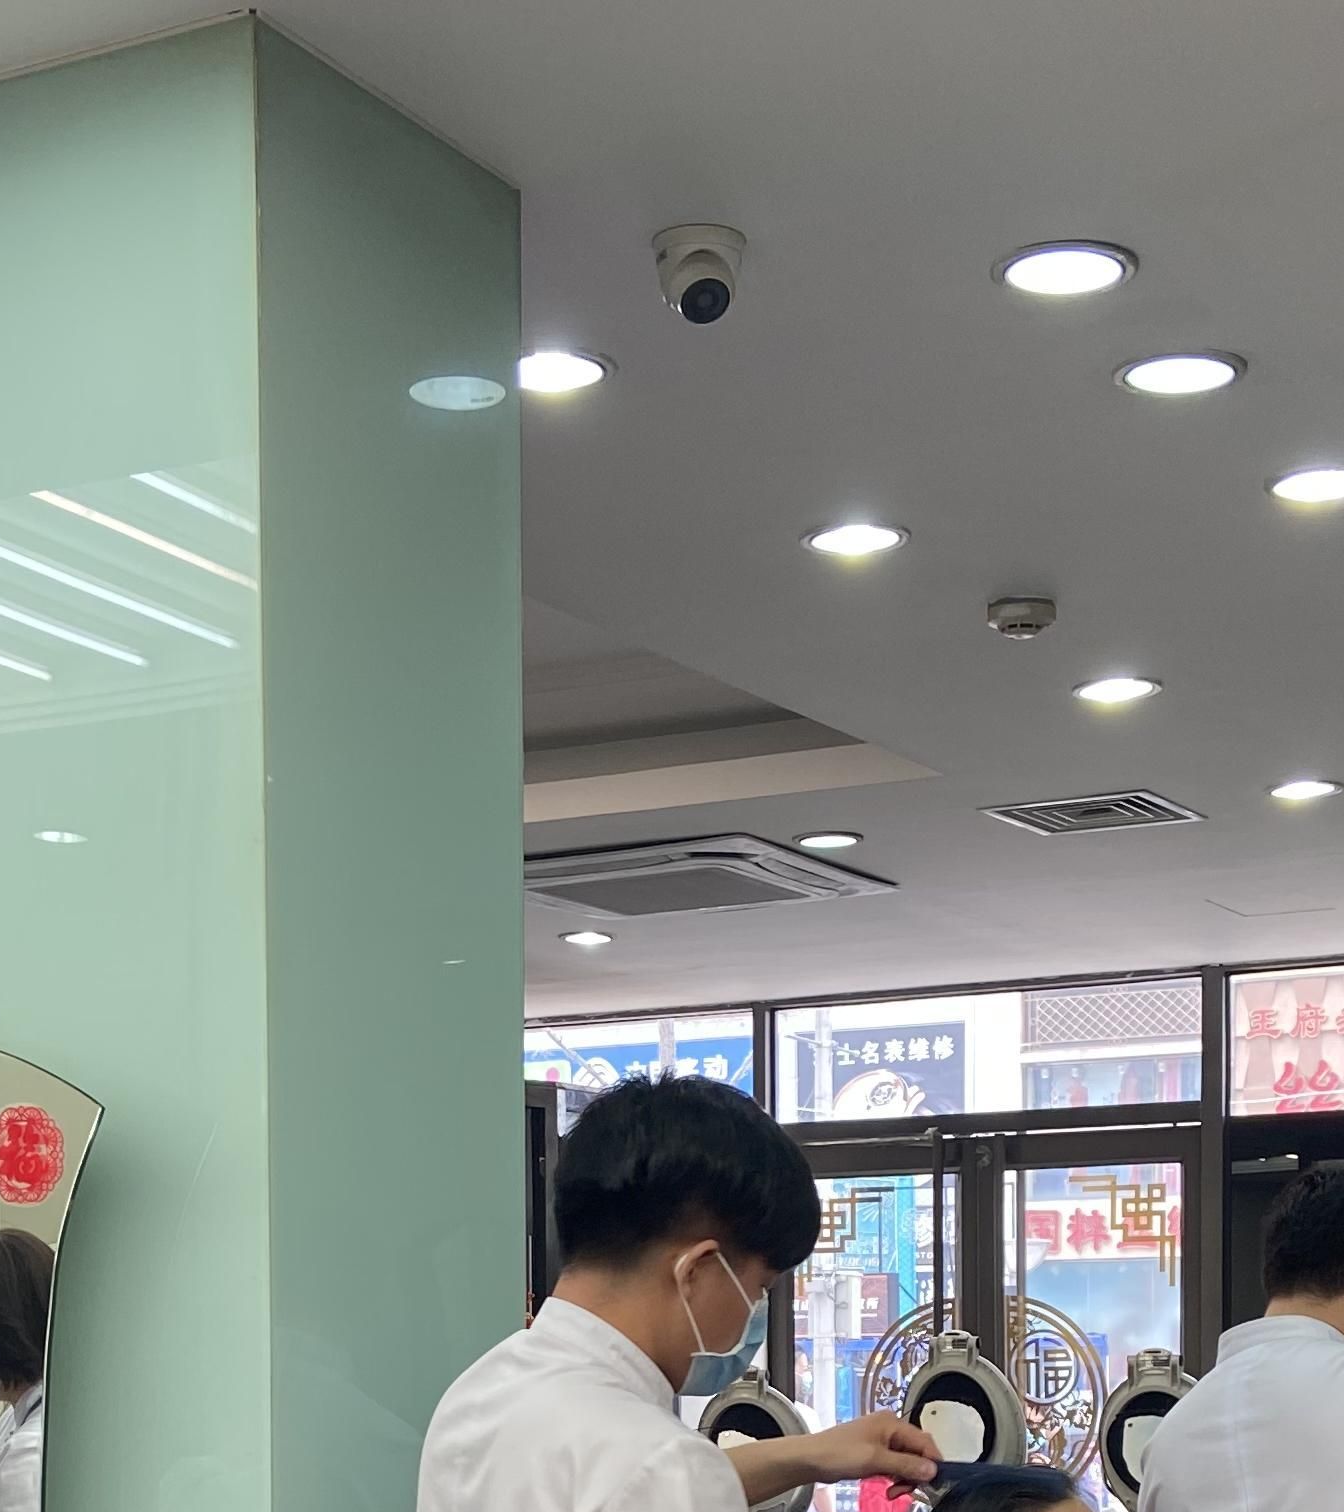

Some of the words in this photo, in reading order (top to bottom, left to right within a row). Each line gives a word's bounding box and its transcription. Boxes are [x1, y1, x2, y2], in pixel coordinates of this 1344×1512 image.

[812, 1035, 955, 1067] 士名表维修
